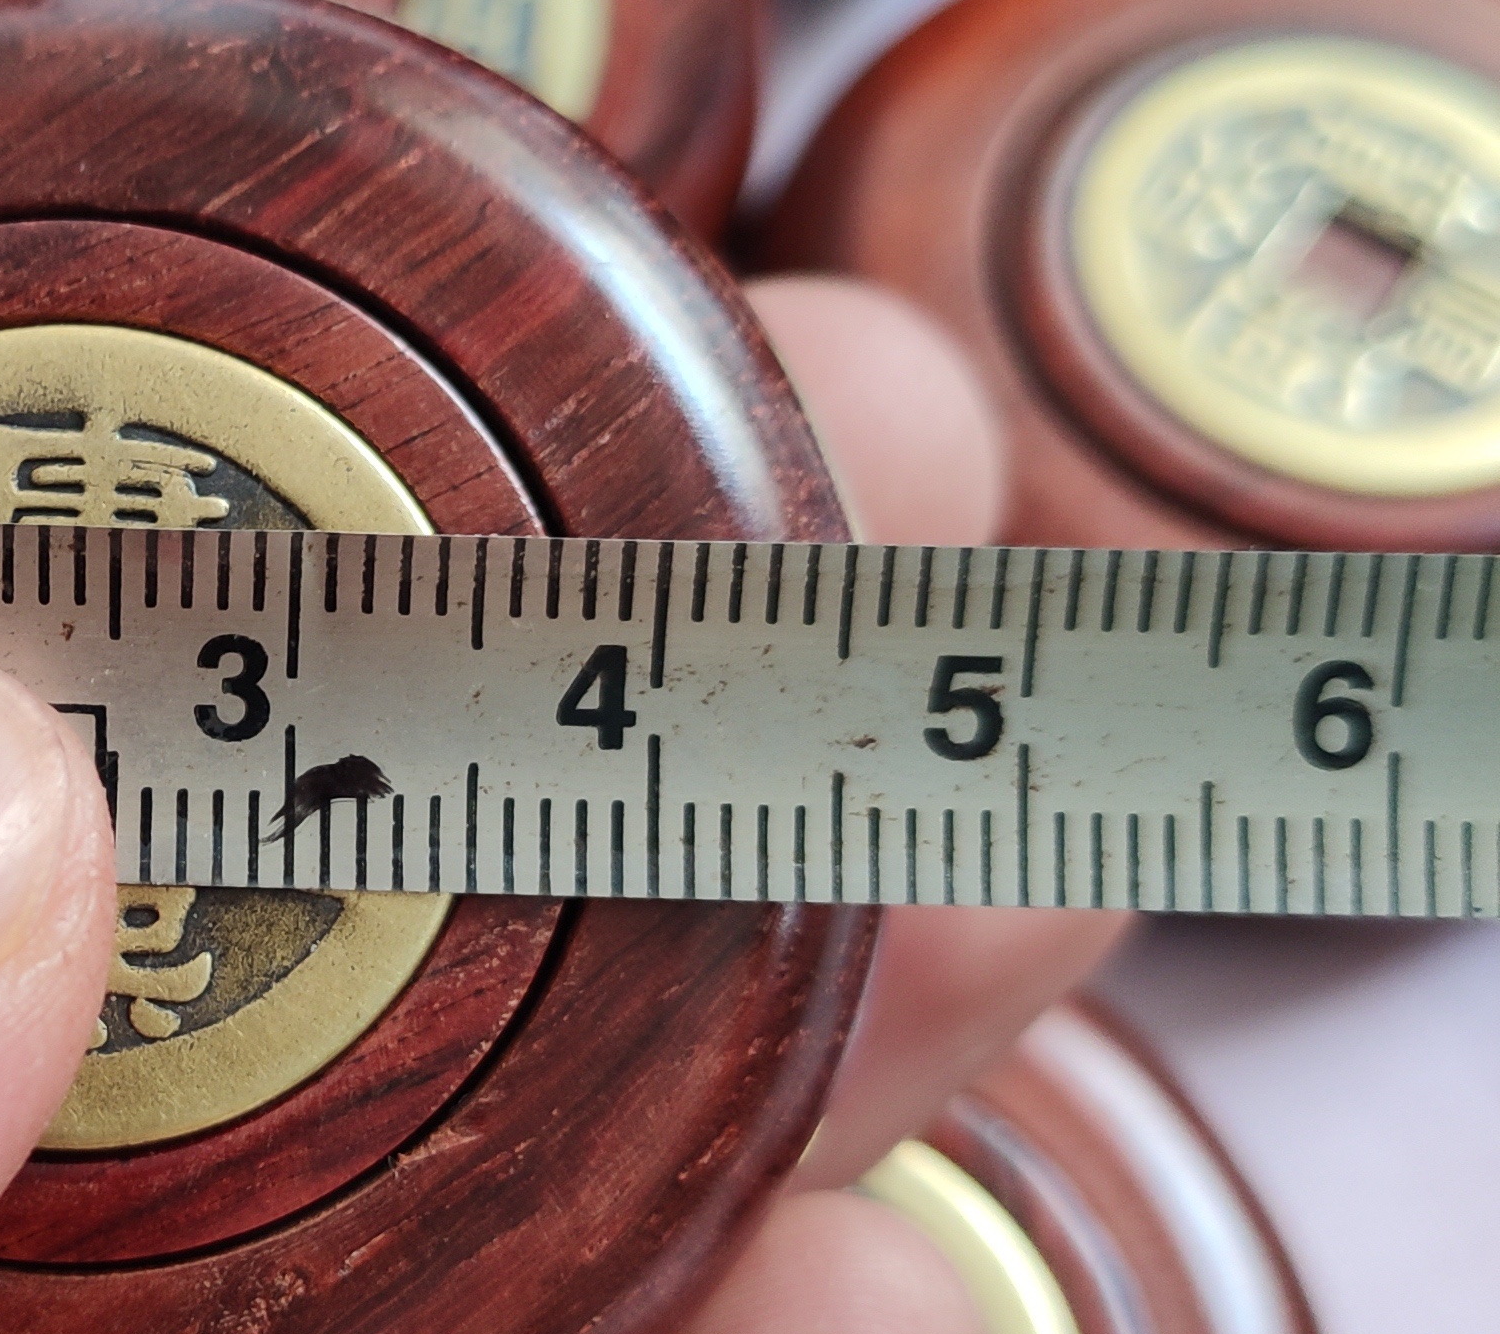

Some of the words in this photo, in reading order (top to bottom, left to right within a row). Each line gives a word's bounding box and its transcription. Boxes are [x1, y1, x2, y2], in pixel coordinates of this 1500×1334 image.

[193, 633, 271, 743] 3
[555, 644, 637, 751] 4
[923, 654, 1006, 762] 5
[1292, 659, 1378, 771] 6
